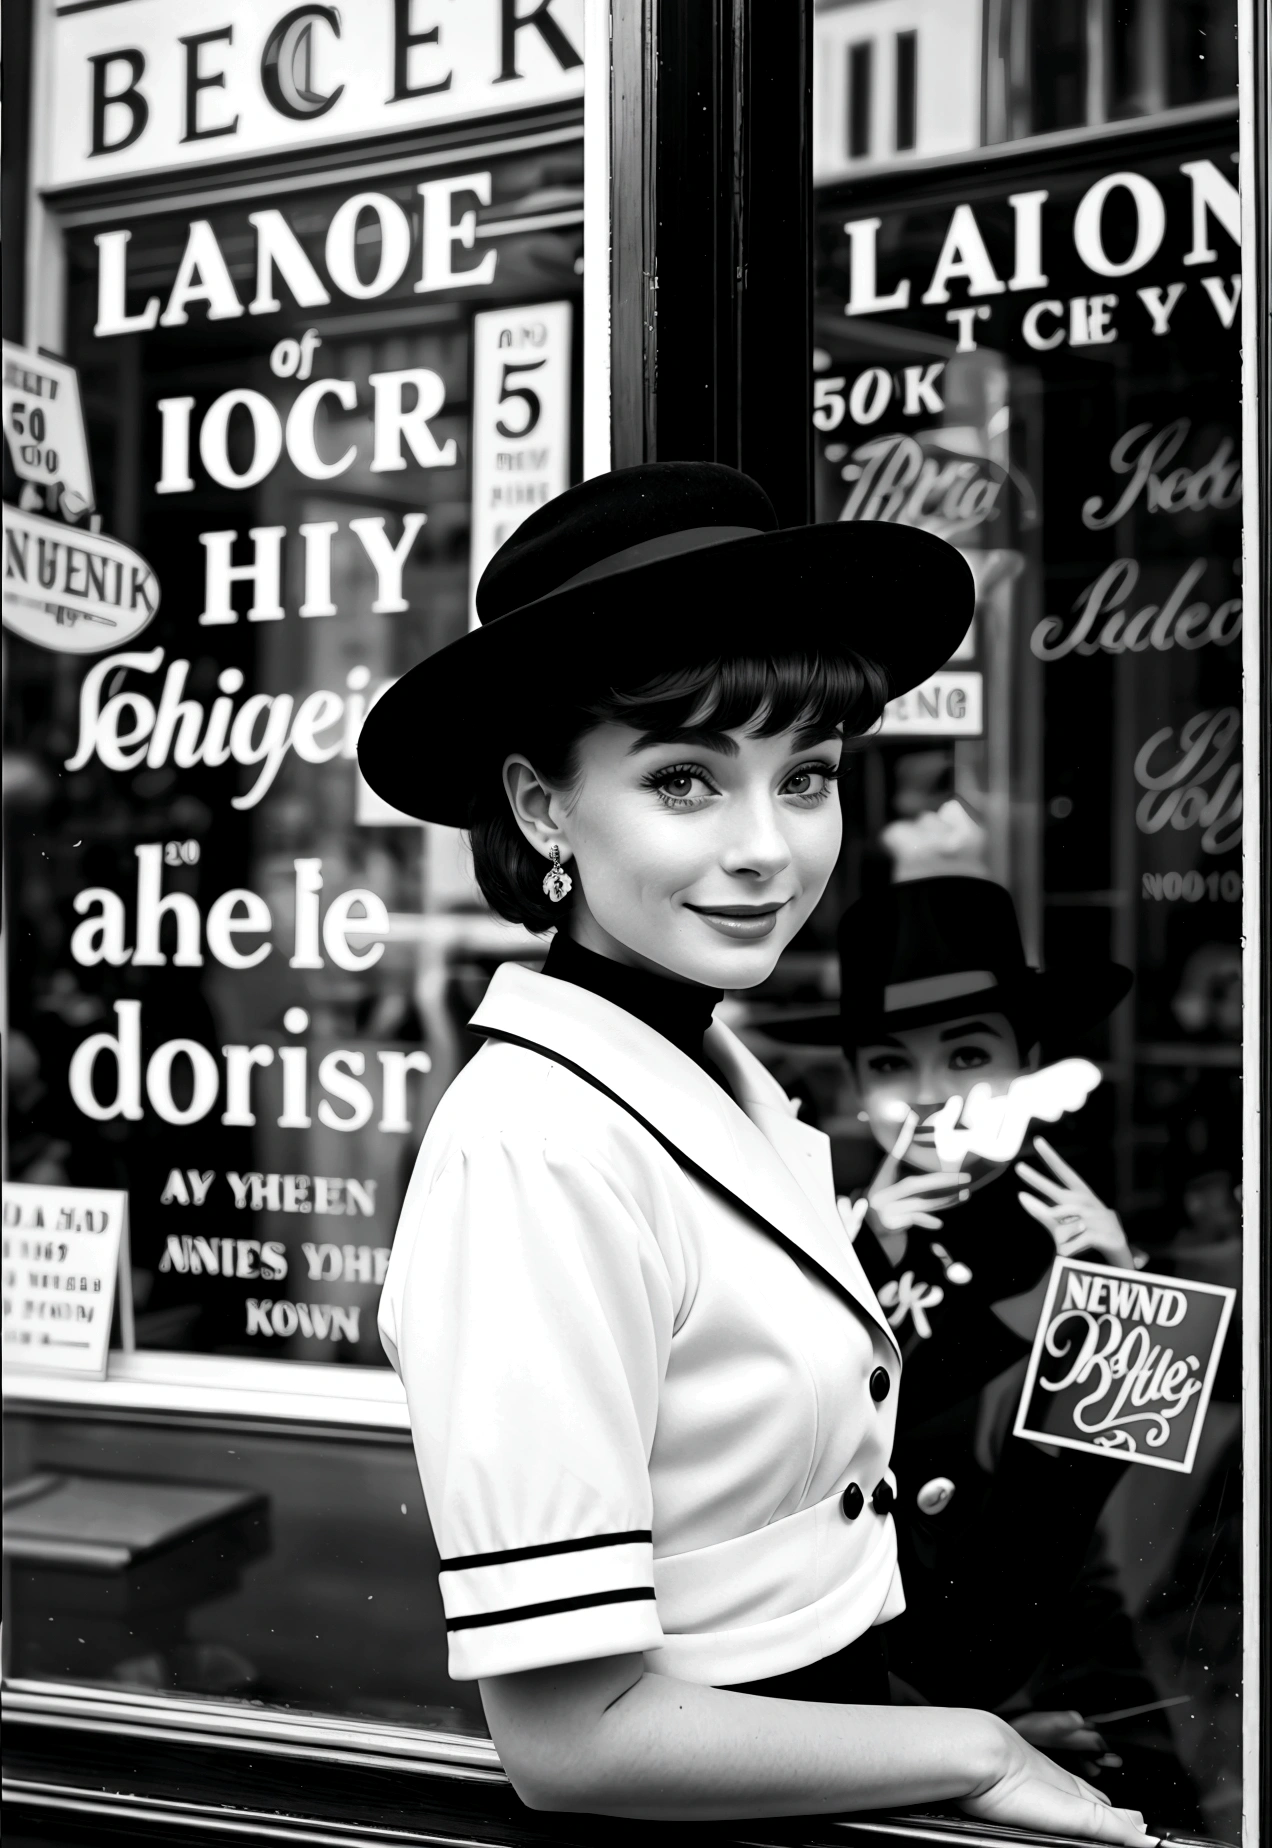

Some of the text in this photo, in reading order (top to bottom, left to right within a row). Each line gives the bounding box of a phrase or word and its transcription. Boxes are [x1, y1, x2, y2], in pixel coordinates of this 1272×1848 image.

[94, 171, 497, 337] LANOE
[844, 159, 1241, 316] LAION
[270, 328, 321, 379] of
[496, 358, 548, 438] 5
[156, 367, 457, 494] IOCR
[199, 513, 427, 625] HIY
[70, 843, 273, 967] ahe
[69, 1000, 432, 1133] dorisr
[160, 1168, 216, 1206] AY
[245, 1298, 361, 1343] KOWN
[1061, 1271, 1188, 1327] NEWND
